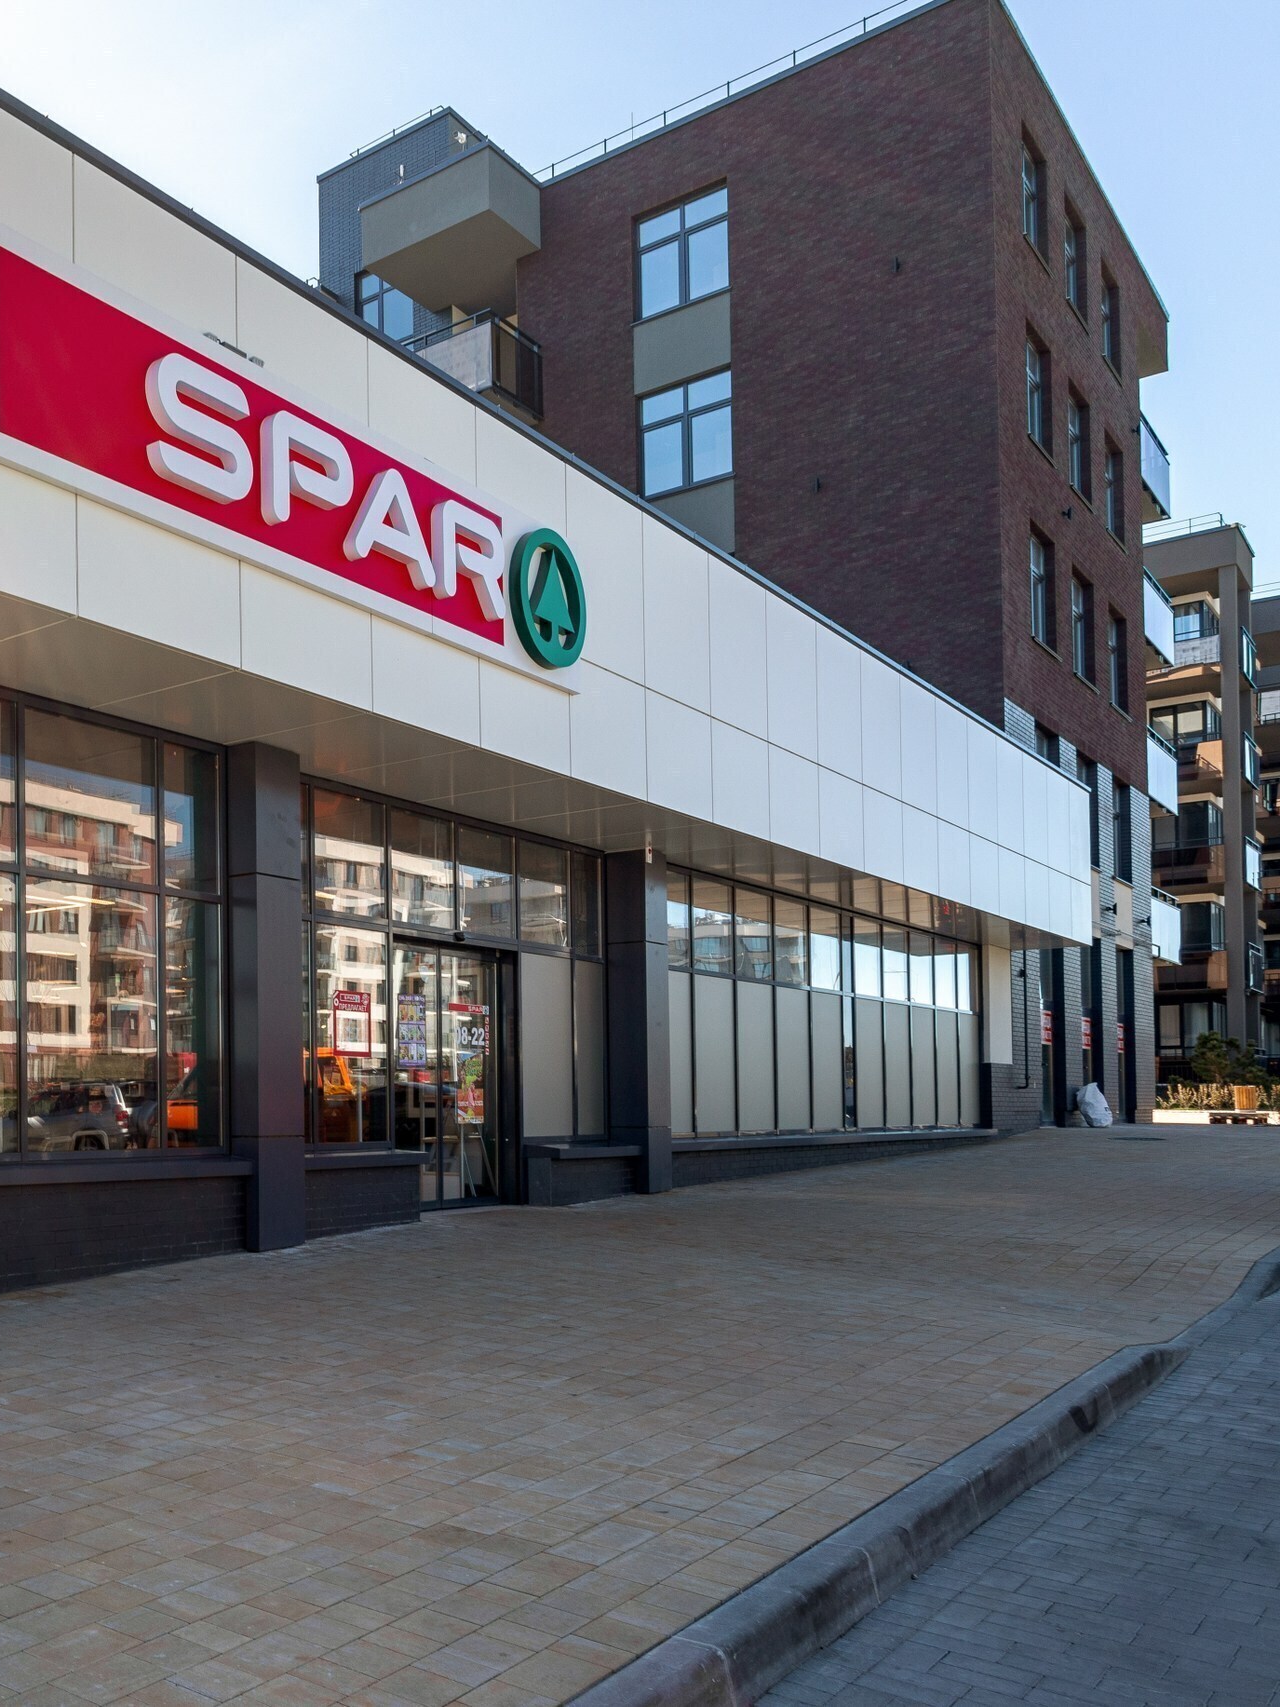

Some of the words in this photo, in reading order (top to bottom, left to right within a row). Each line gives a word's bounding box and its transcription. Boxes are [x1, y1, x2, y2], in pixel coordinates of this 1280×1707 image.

[145, 352, 507, 622] SPAR
[338, 1003, 368, 1012] ПРЕДЛАГАЕТ
[467, 1005, 484, 1013] SPAR
[455, 1026, 485, 1046] 08-22
